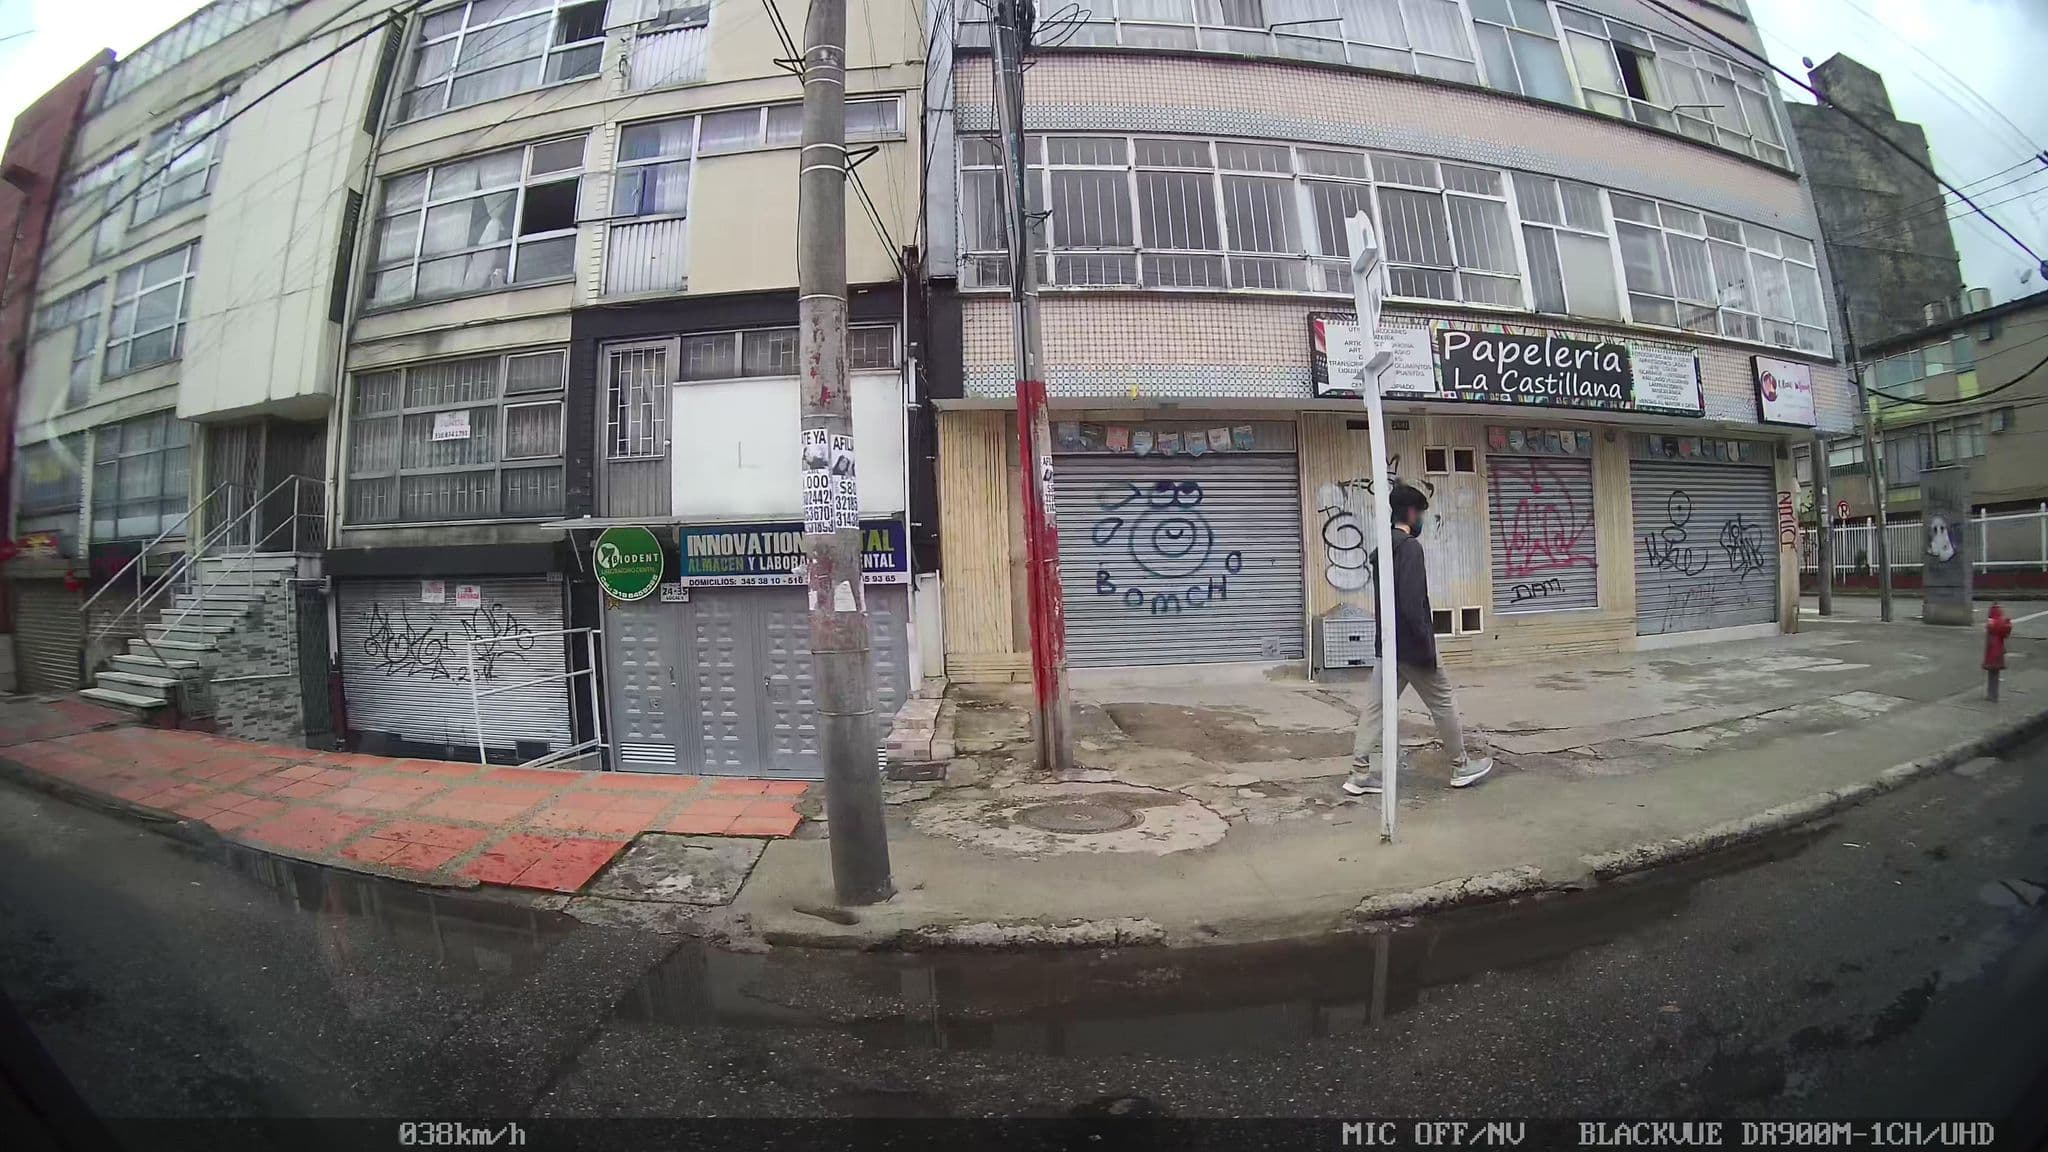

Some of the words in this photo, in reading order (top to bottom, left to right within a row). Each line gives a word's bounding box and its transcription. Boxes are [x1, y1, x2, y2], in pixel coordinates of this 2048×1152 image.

[1443, 331, 1622, 374] Papelería
[1454, 367, 1489, 391] La
[1500, 370, 1623, 400] Castillana
[813, 430, 827, 444] YA
[802, 474, 829, 489] 000
[687, 531, 806, 557] INNOVATION
[687, 557, 744, 573] ALMACEN
[747, 556, 755, 571] Y
[741, 577, 756, 585] 345
[758, 577, 768, 585] 38
[885, 574, 896, 582] 65
